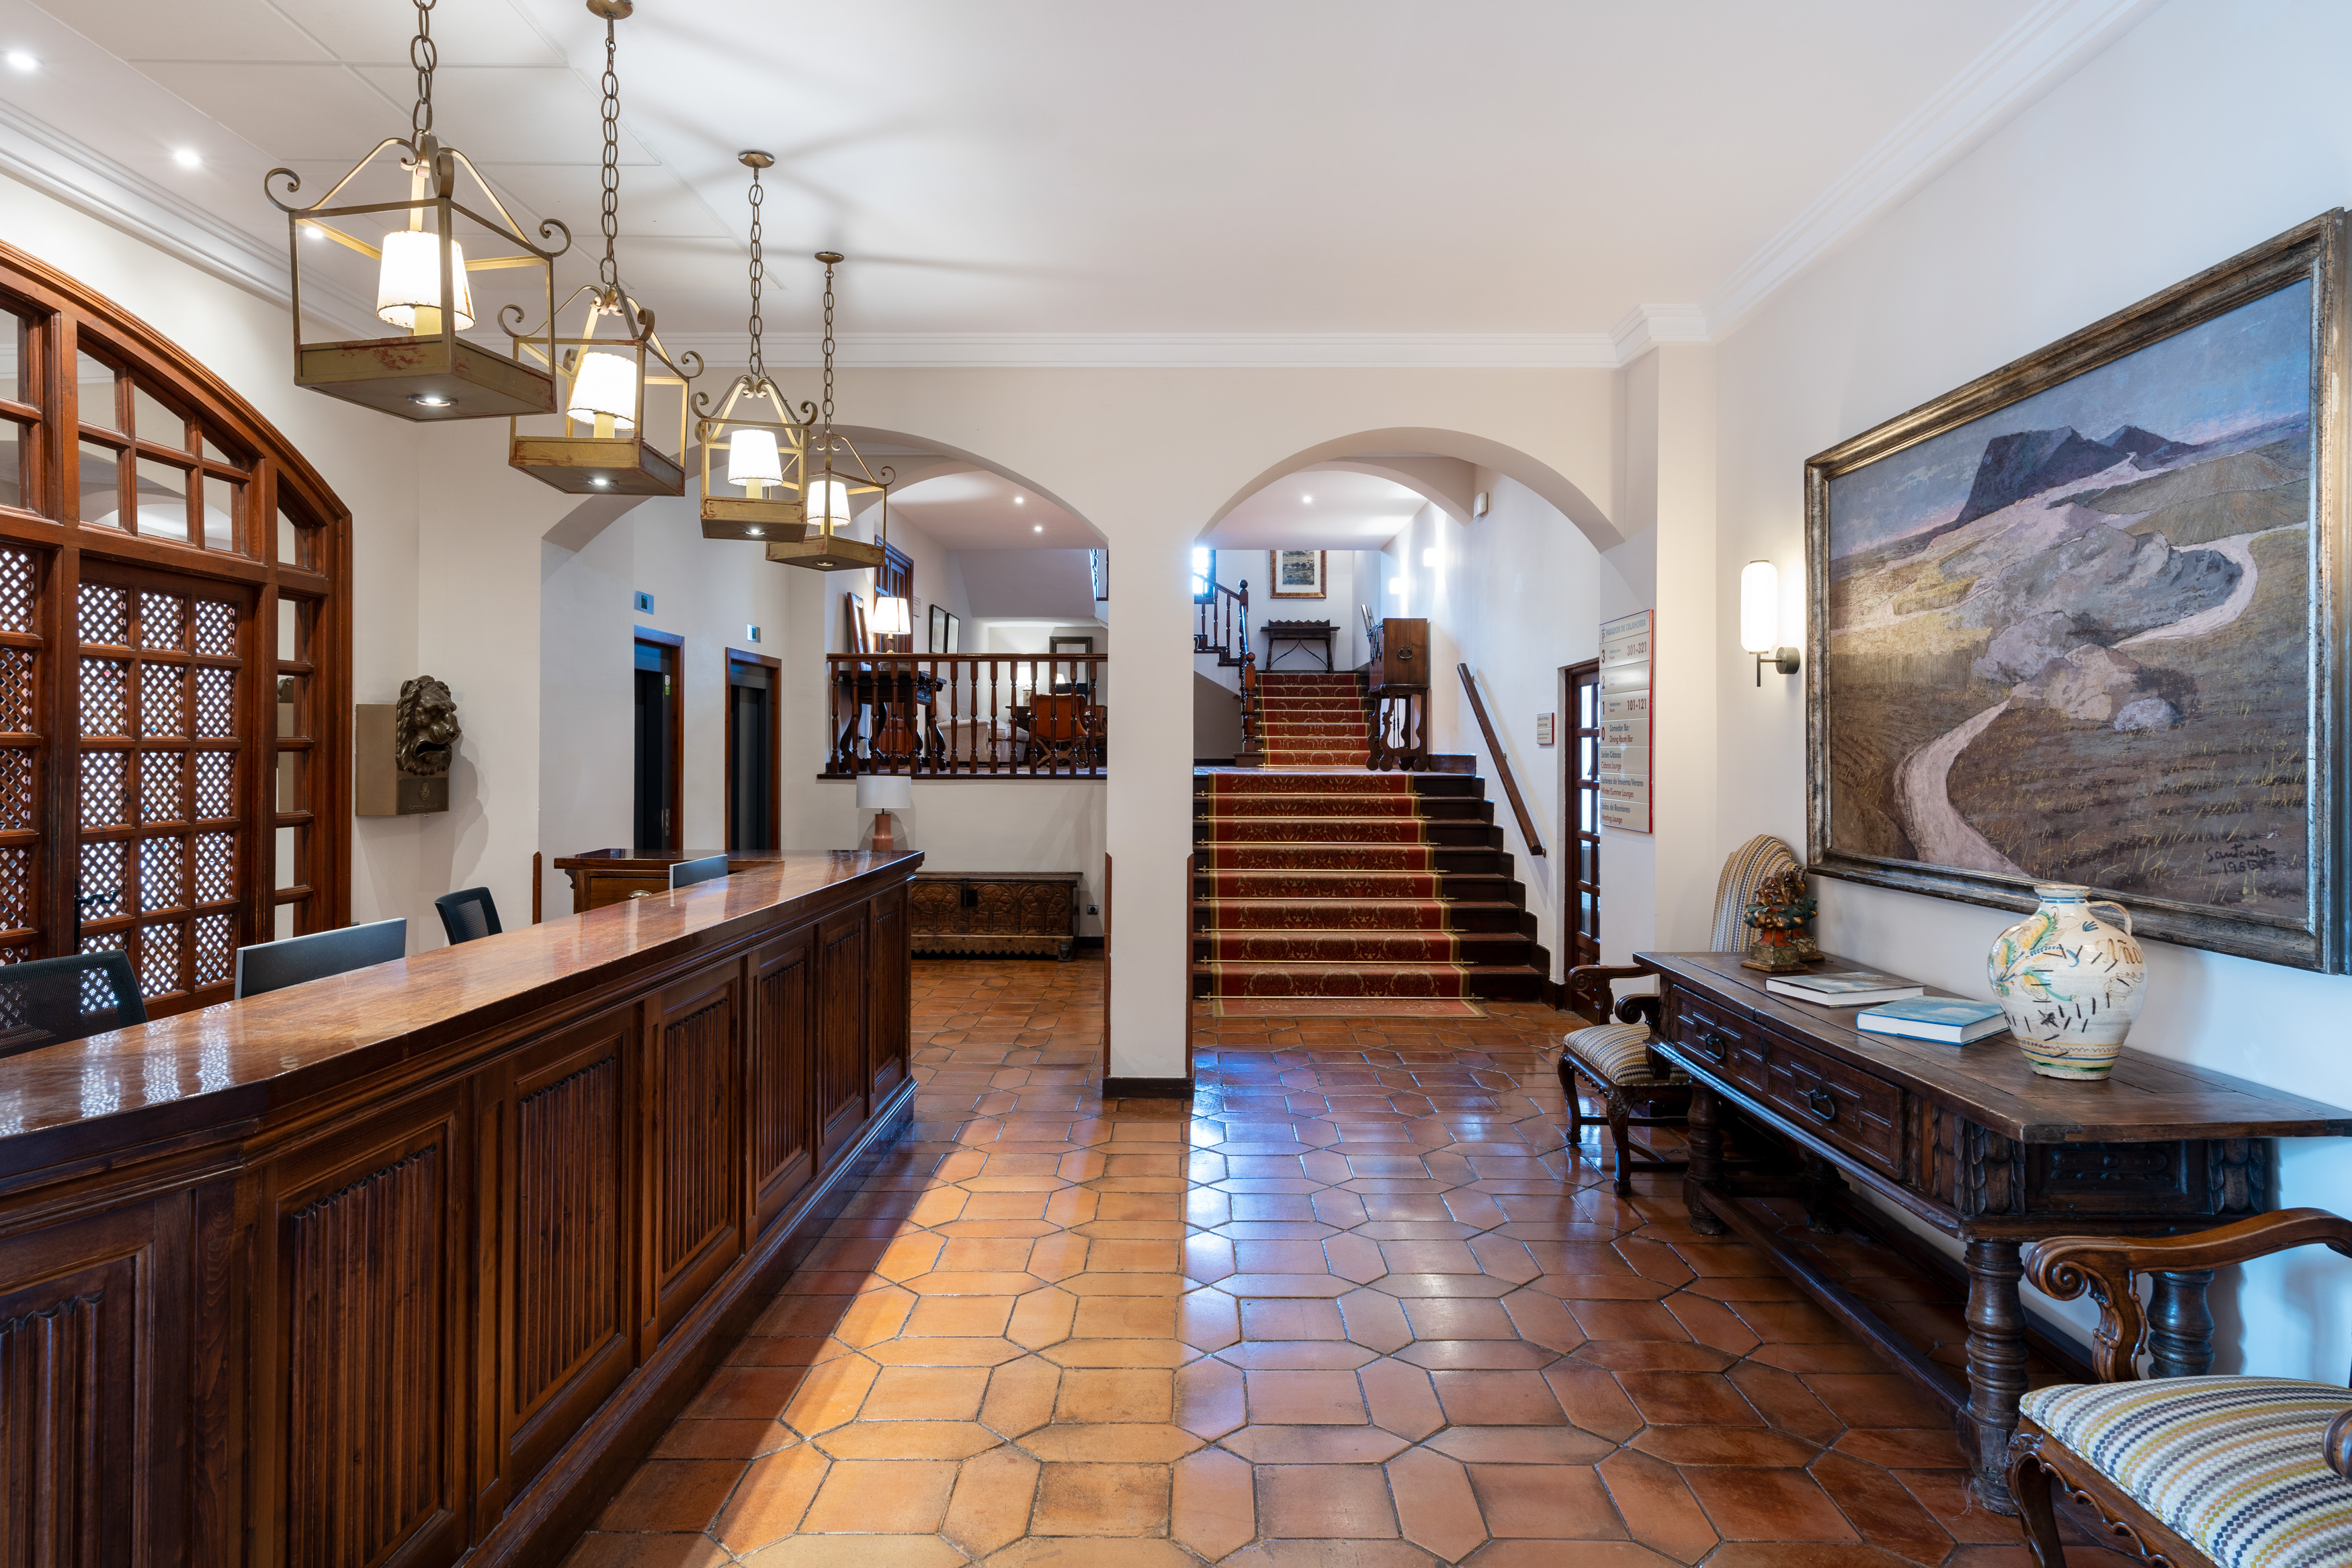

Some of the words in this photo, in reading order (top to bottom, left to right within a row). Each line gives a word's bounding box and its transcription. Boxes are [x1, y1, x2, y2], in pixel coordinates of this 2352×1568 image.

[1606, 625, 1620, 636] PARADOR
[1621, 624, 1626, 632] DE
[1626, 618, 1646, 631] CALAHORRA
[1627, 641, 1646, 656] 301-321
[1601, 649, 1605, 664] 3
[1601, 675, 1605, 689] 2
[1602, 701, 1605, 715] 1
[1627, 698, 1646, 711] 101-121
[1601, 726, 1605, 741] 0
[1609, 735, 1618, 744] Dining
[1611, 761, 1622, 771] Lounge
[1601, 777, 1612, 785] Salones
[1613, 777, 1617, 785] de
[1622, 789, 1634, 799] Lounges
[1610, 803, 1613, 811] de
[1614, 803, 1630, 813] Reuniones
[1601, 814, 1611, 823] Meeting
[1612, 814, 1622, 825] Lounge
